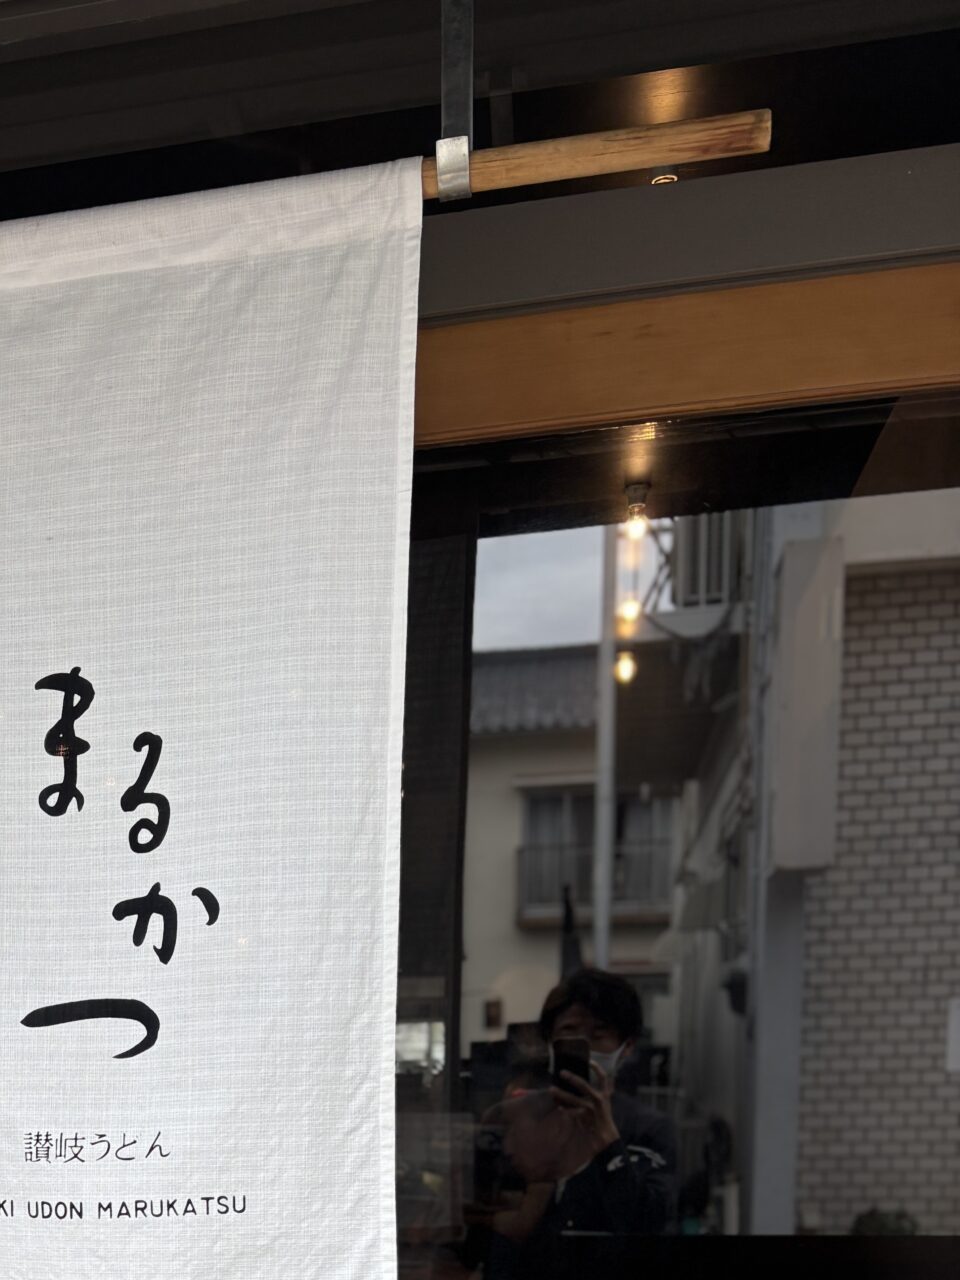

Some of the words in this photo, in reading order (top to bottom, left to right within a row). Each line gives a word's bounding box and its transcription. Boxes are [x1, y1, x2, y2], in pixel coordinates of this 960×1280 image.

[24, 1130, 171, 1164] 讃岐うどん
[27, 1200, 83, 1219] UDON
[98, 1195, 247, 1219] MARUKATSU
